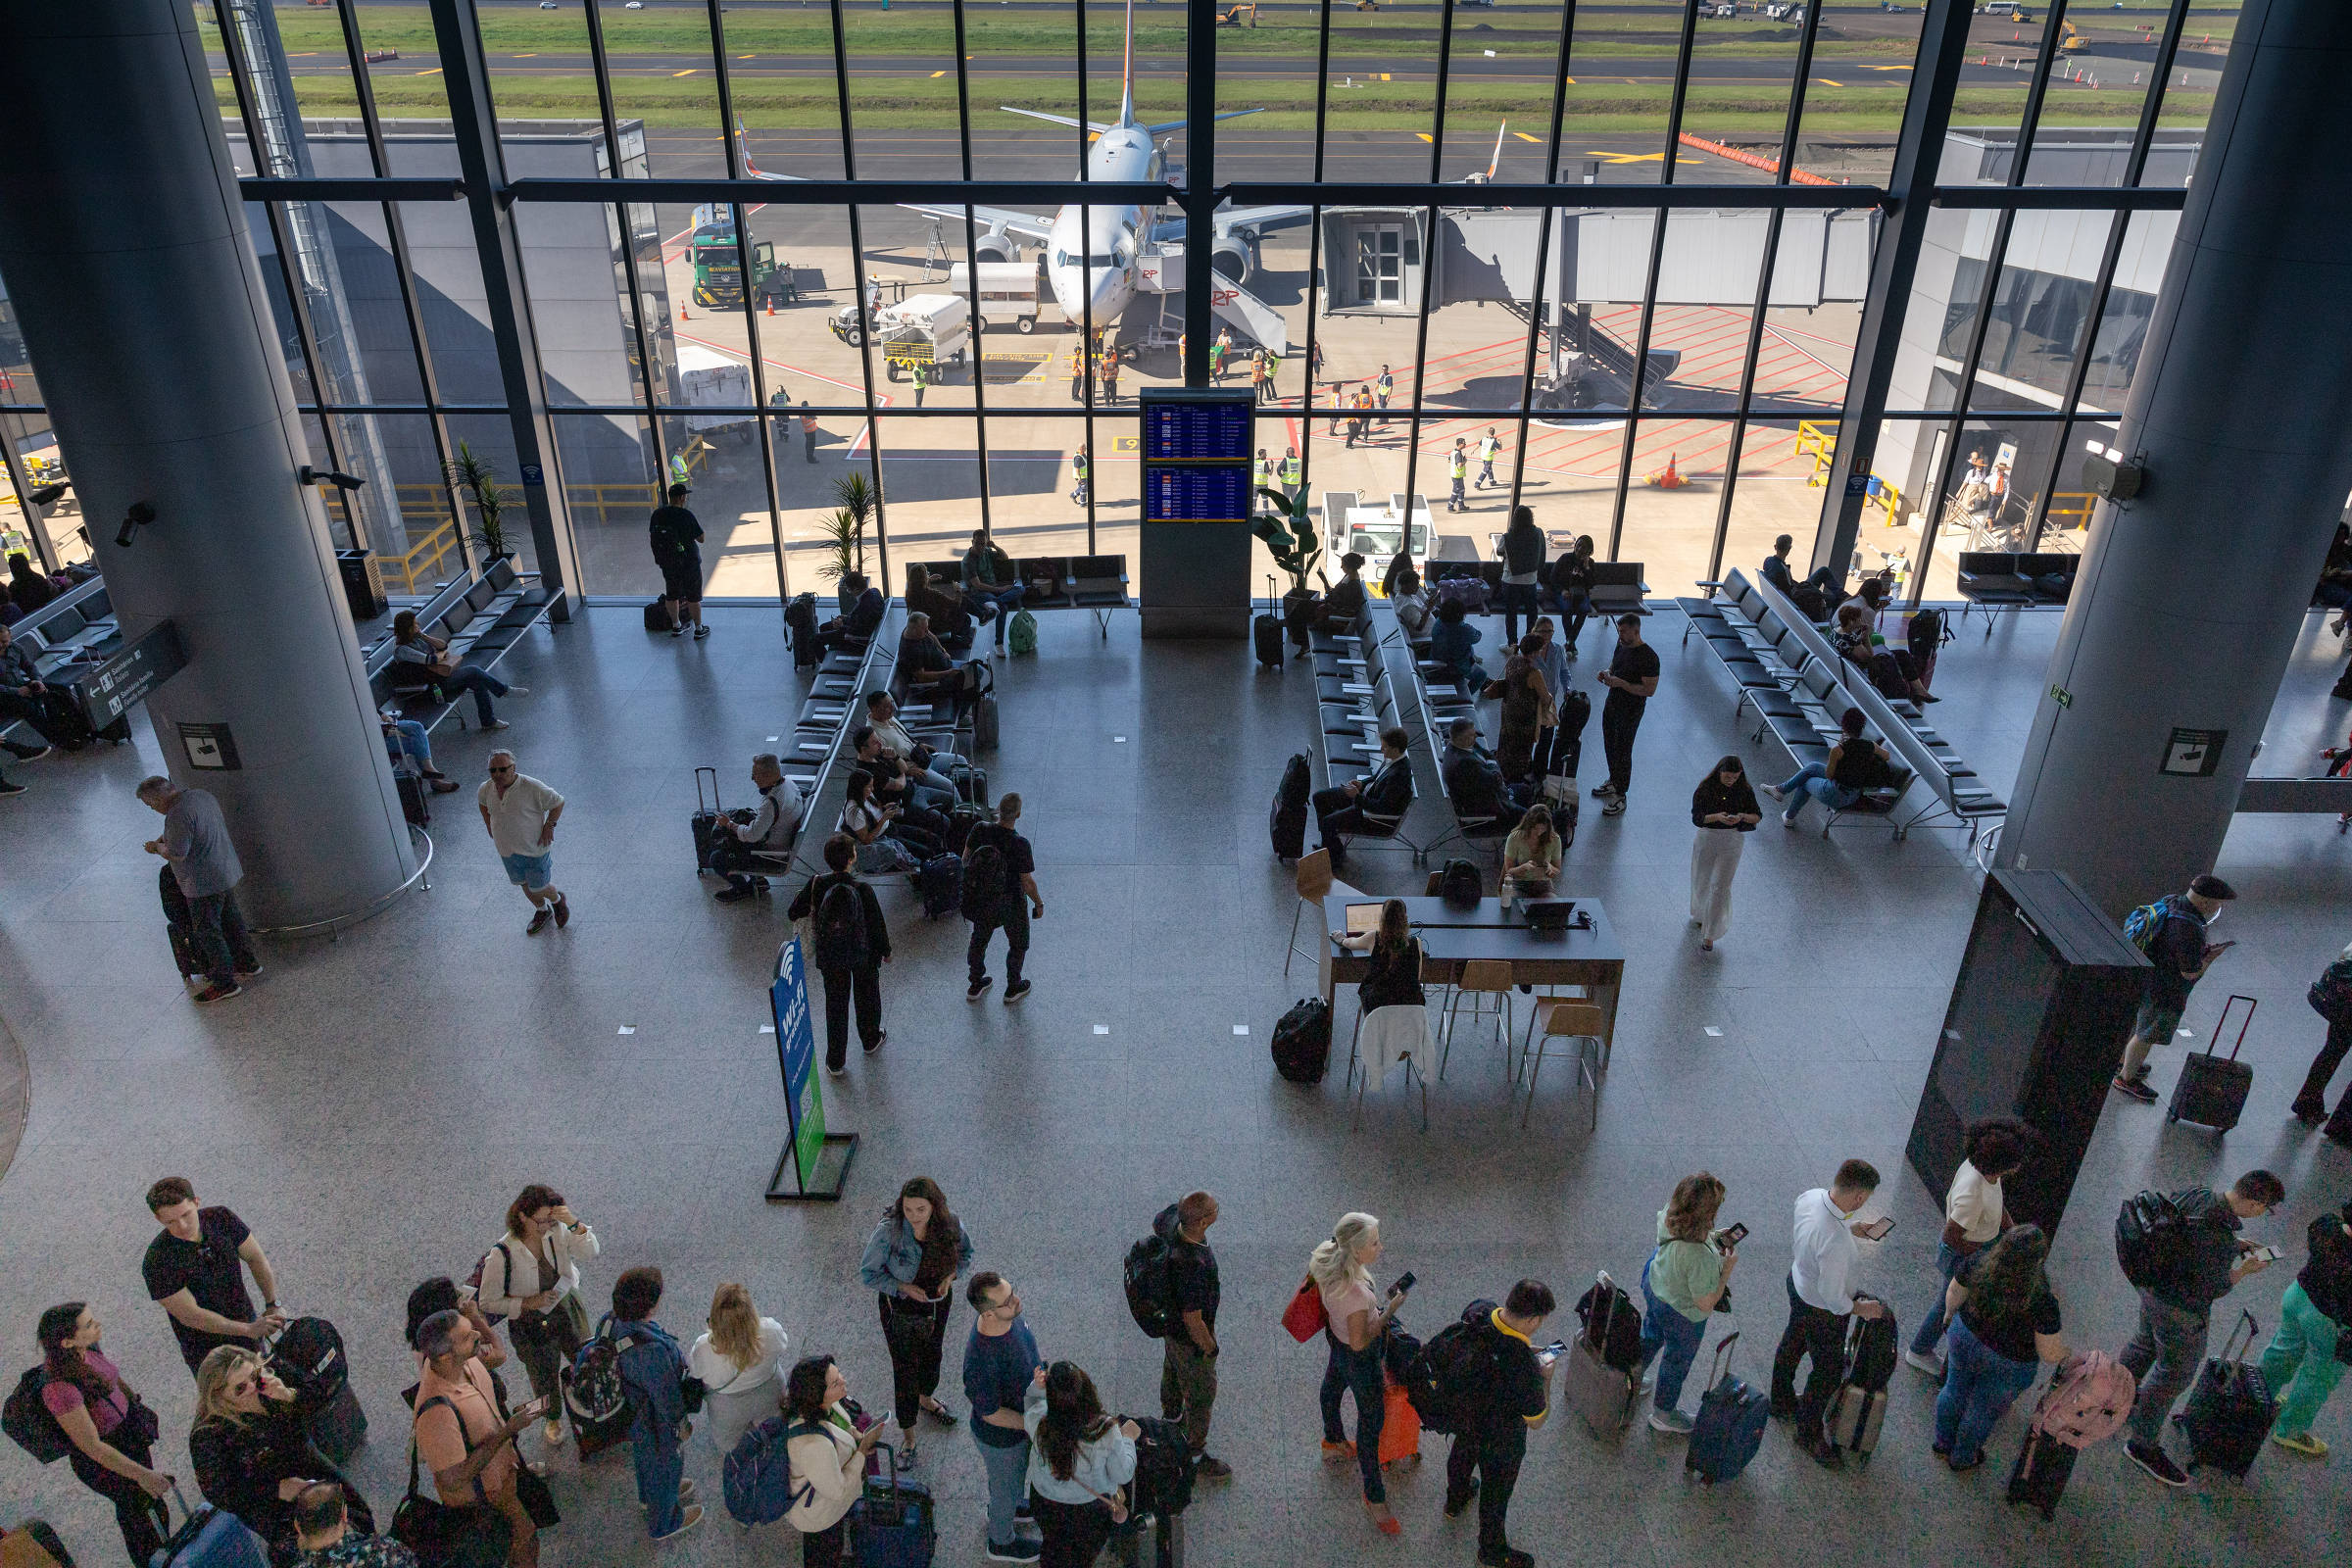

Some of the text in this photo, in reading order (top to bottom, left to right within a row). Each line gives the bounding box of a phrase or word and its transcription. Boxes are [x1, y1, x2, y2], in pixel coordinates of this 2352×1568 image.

[1143, 270, 1157, 278] RP
[1211, 290, 1239, 307] RP
[1125, 439, 1138, 450] 9
[783, 980, 804, 1035] Wi-fi
[786, 1002, 806, 1054] gratuito
